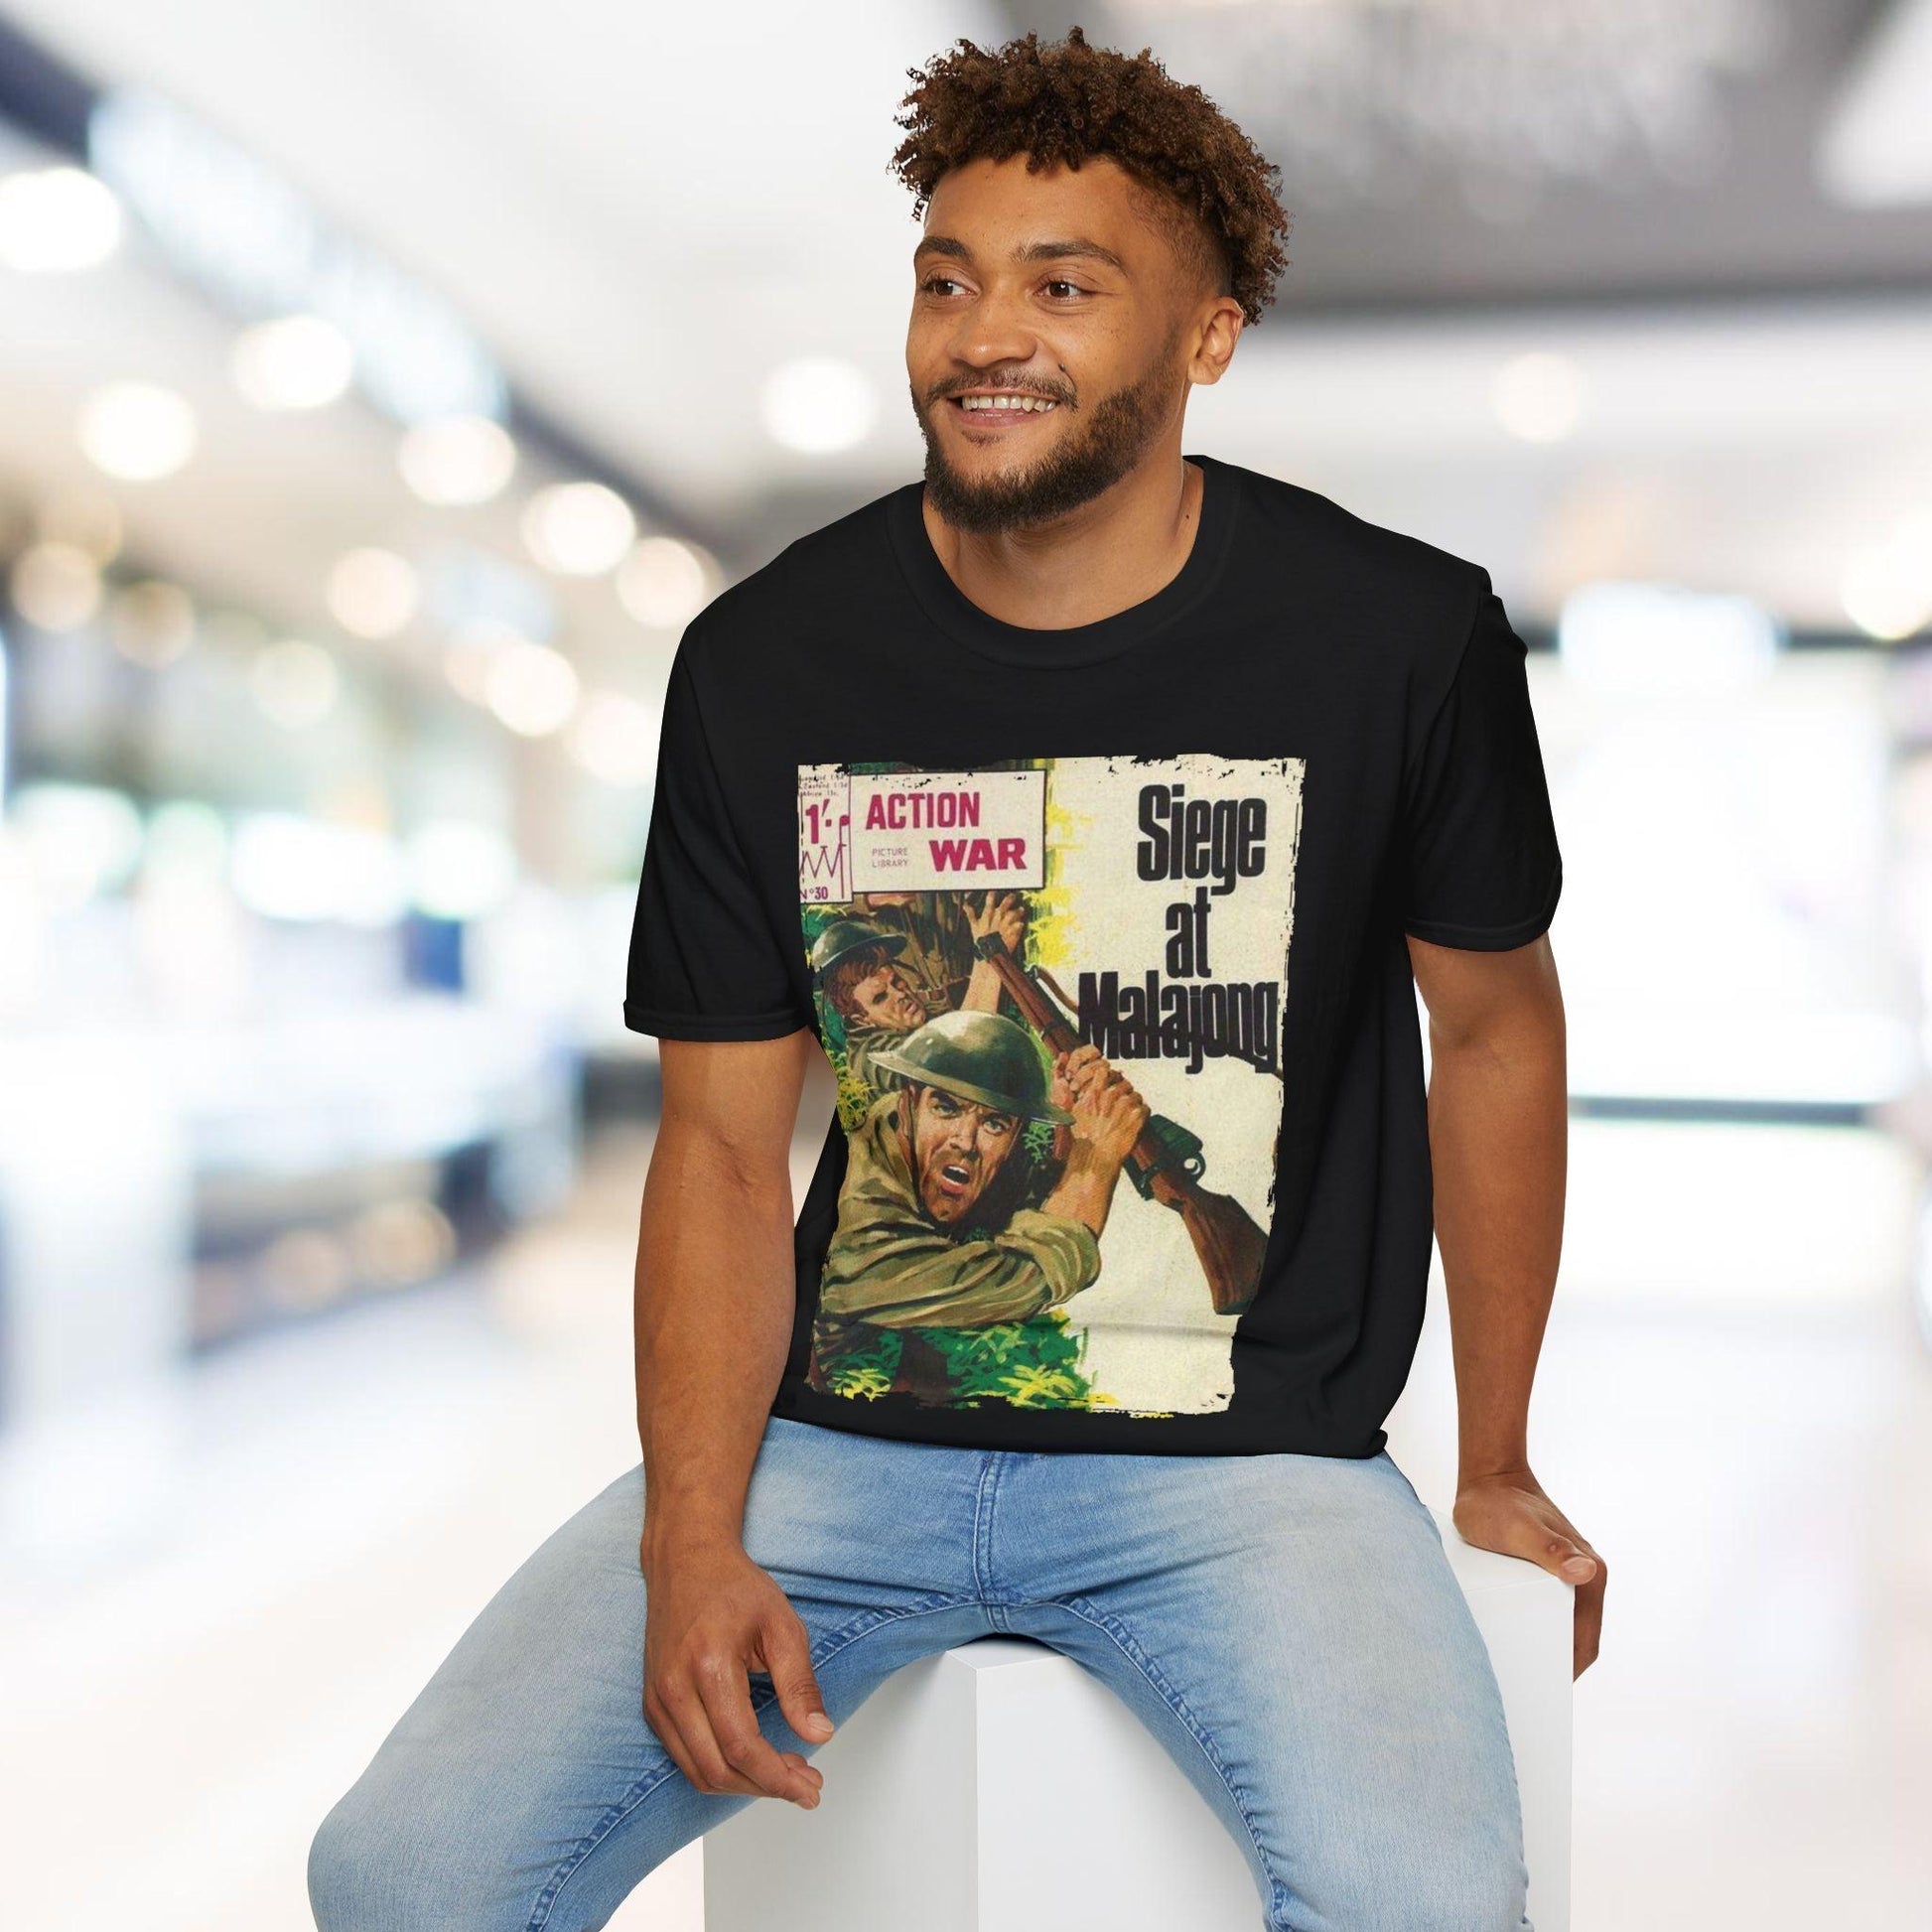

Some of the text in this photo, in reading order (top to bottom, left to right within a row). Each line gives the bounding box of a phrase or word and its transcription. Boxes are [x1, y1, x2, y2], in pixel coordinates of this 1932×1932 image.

[866, 792, 980, 830] ACTION
[872, 847, 908, 857] PICTURE
[928, 838, 1028, 872] WAR
[1137, 784, 1267, 896] Siege
[872, 859, 908, 869] LIBRARY
[1166, 887, 1212, 979] at
[1078, 970, 1279, 1074] Malajong
